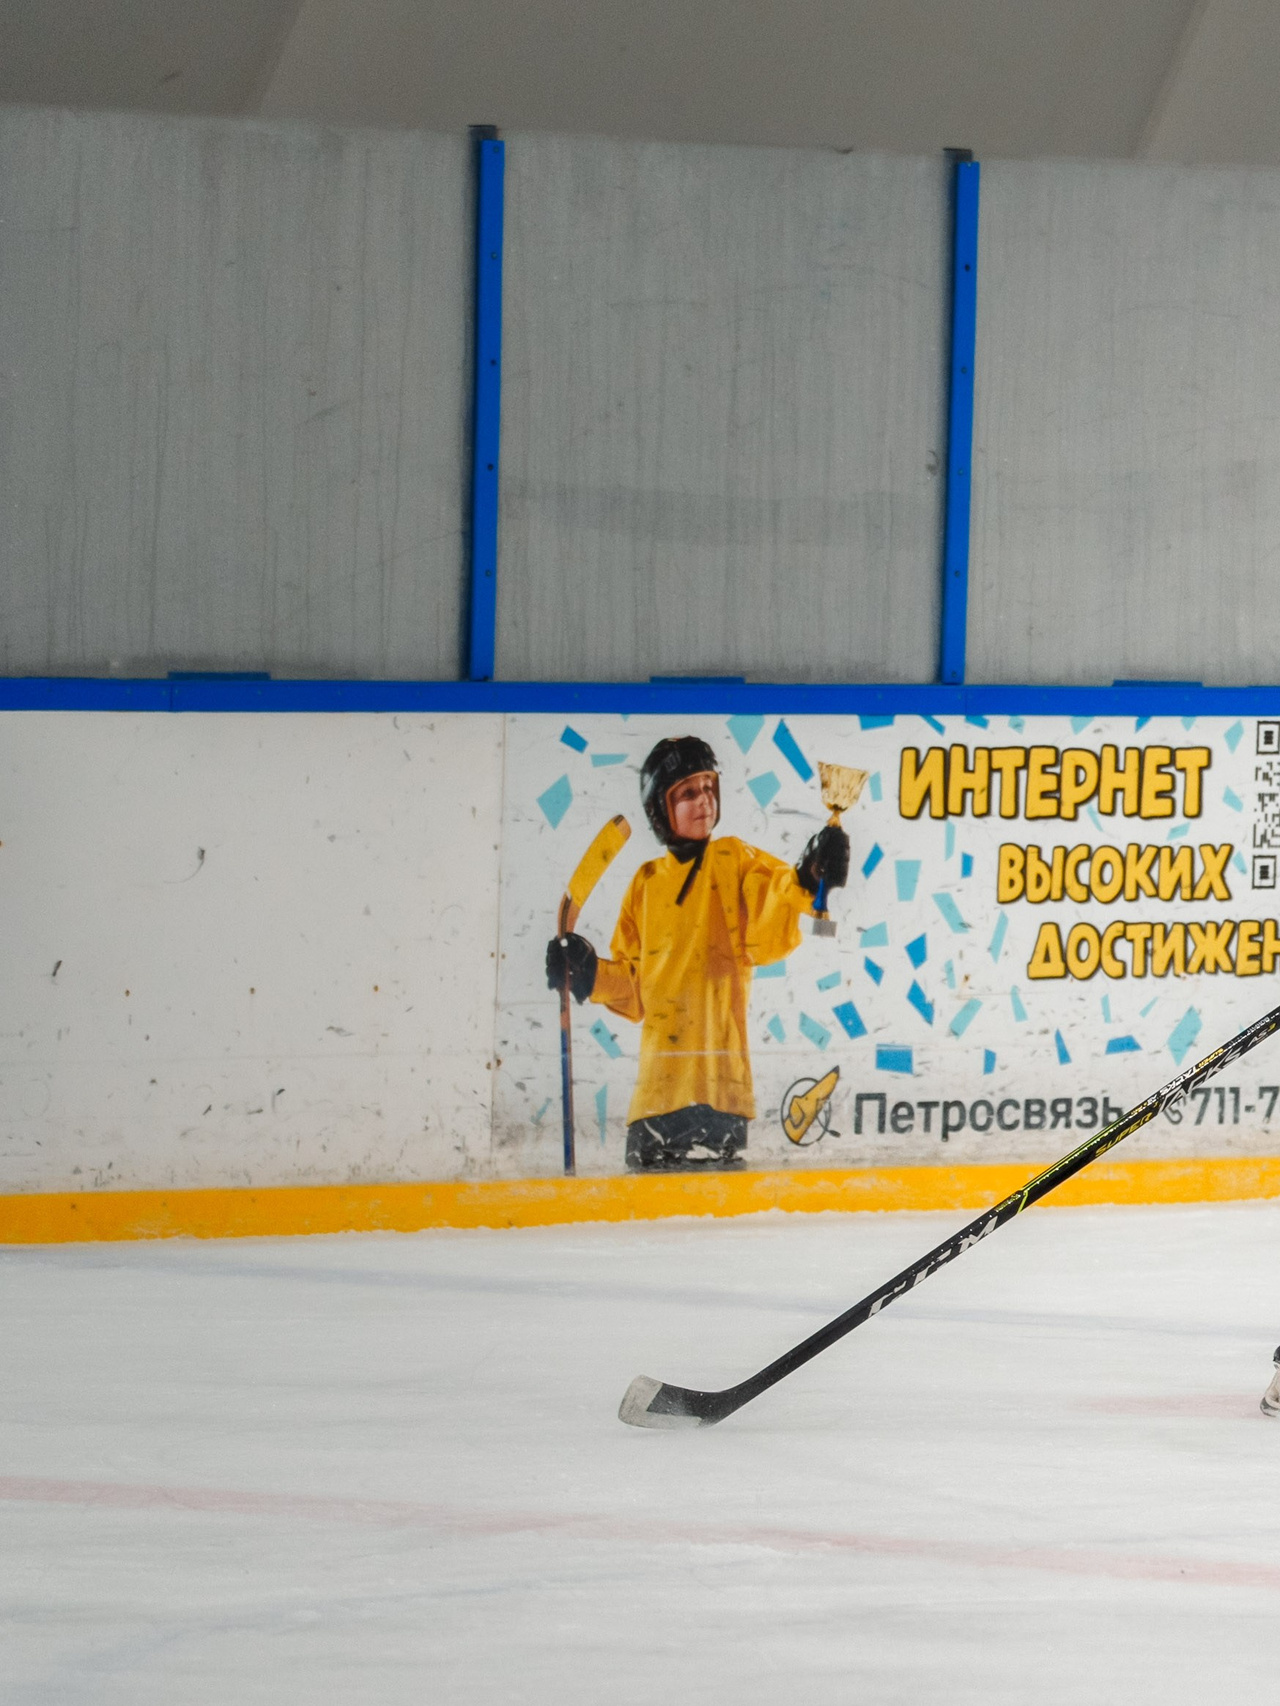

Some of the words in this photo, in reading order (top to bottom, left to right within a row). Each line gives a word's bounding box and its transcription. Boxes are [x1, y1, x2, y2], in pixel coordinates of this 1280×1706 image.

[899, 743, 1211, 820] ИНТЕРНЕТ
[997, 842, 1234, 903] ВЫСОКИХ
[854, 1092, 1125, 1143] Петросвязь
